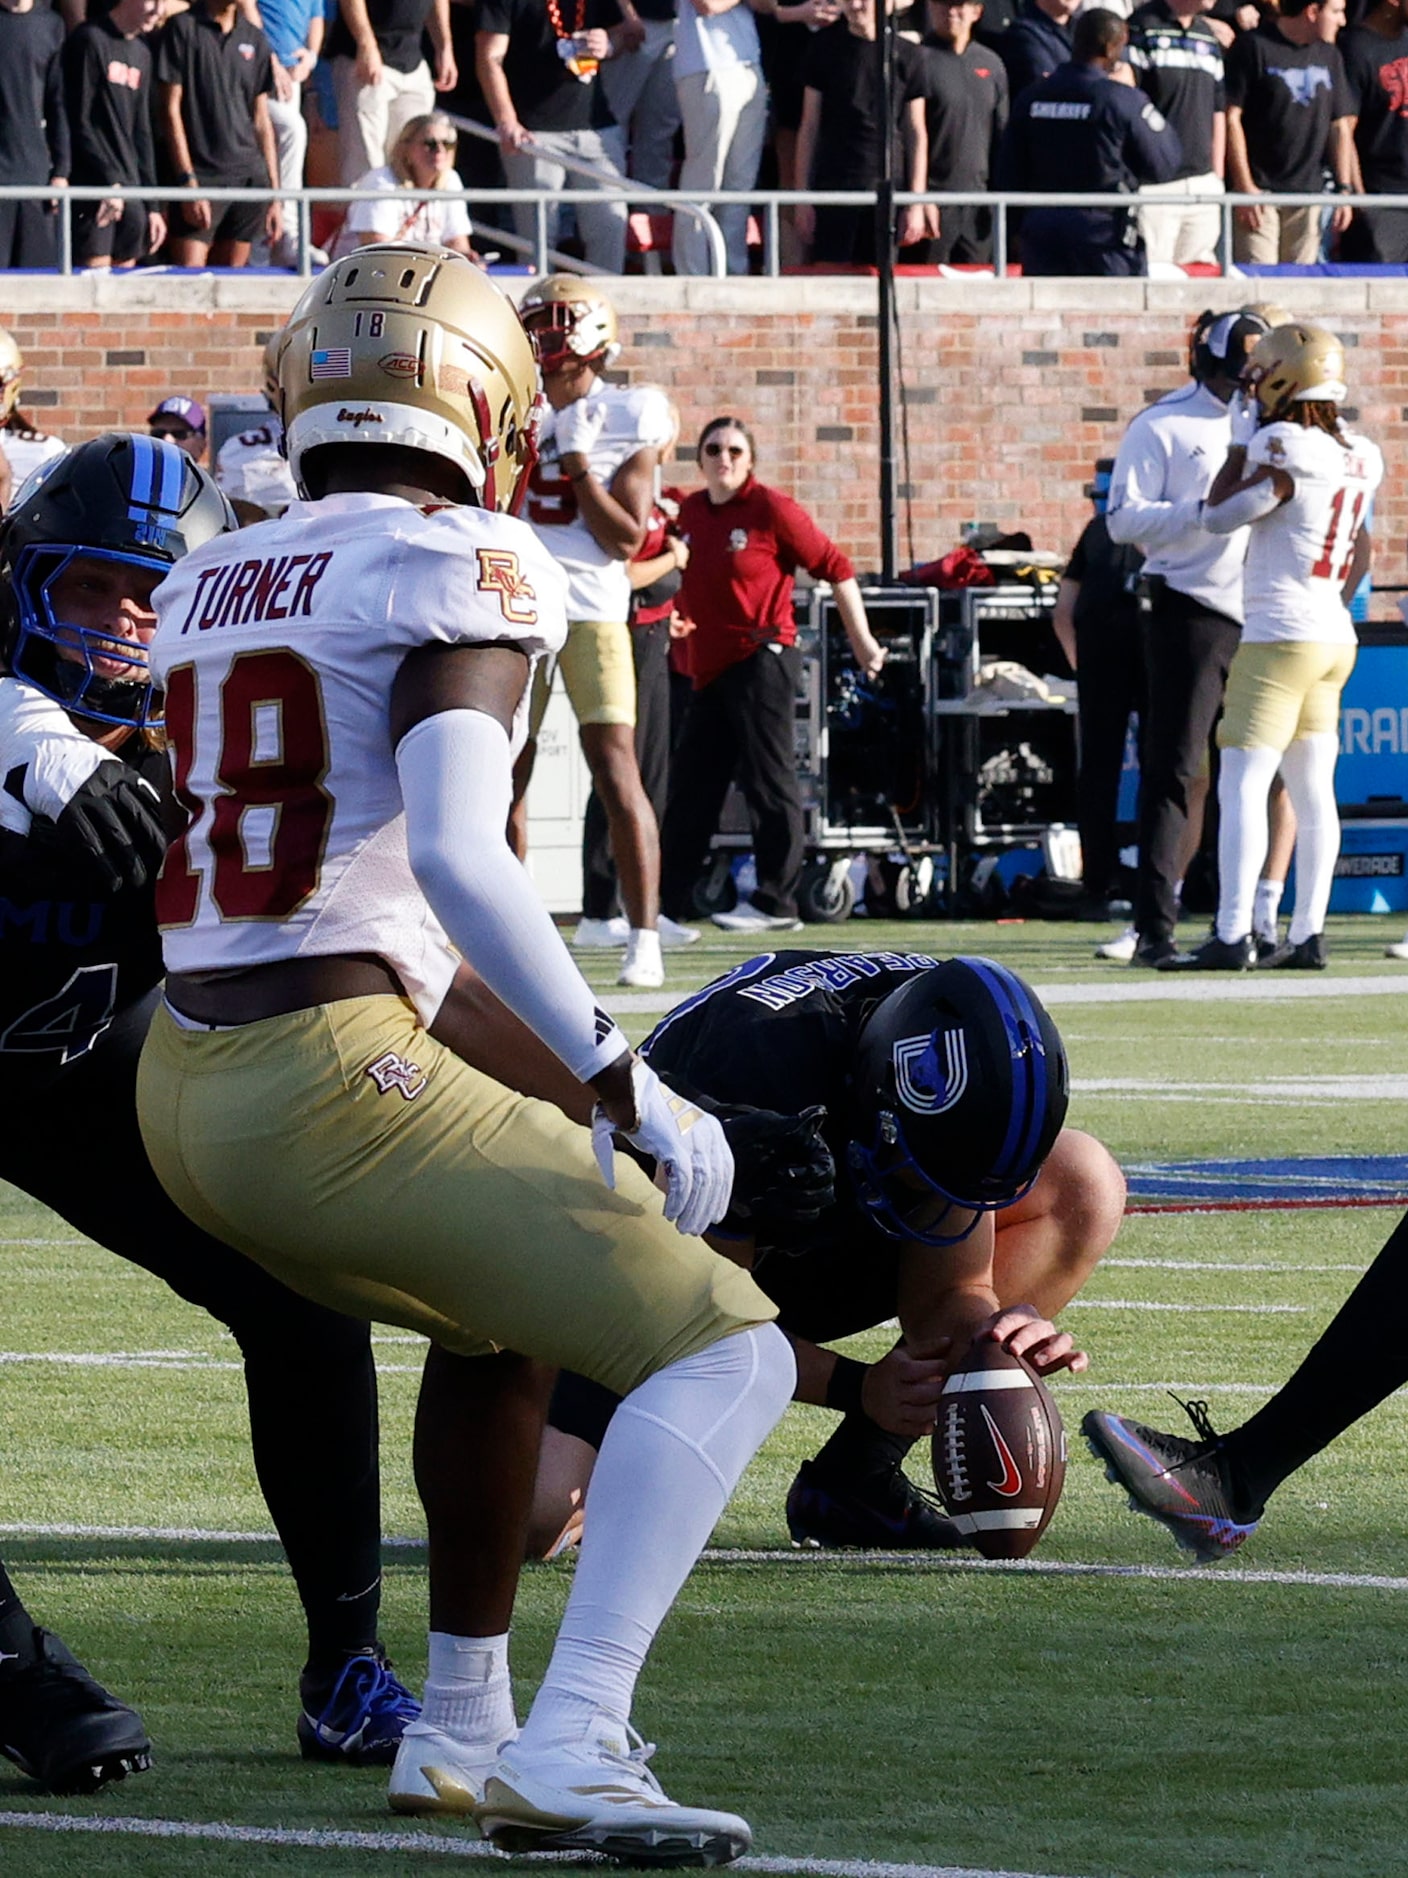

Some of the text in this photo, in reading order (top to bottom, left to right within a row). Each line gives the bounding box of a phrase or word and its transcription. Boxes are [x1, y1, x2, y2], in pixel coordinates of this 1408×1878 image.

[353, 311, 386, 338] 18
[337, 407, 384, 428] Eagles
[181, 550, 333, 635] TURNER
[155, 646, 335, 933] 18
[0, 962, 119, 1066] 4
[736, 951, 940, 1011] PEARSON
